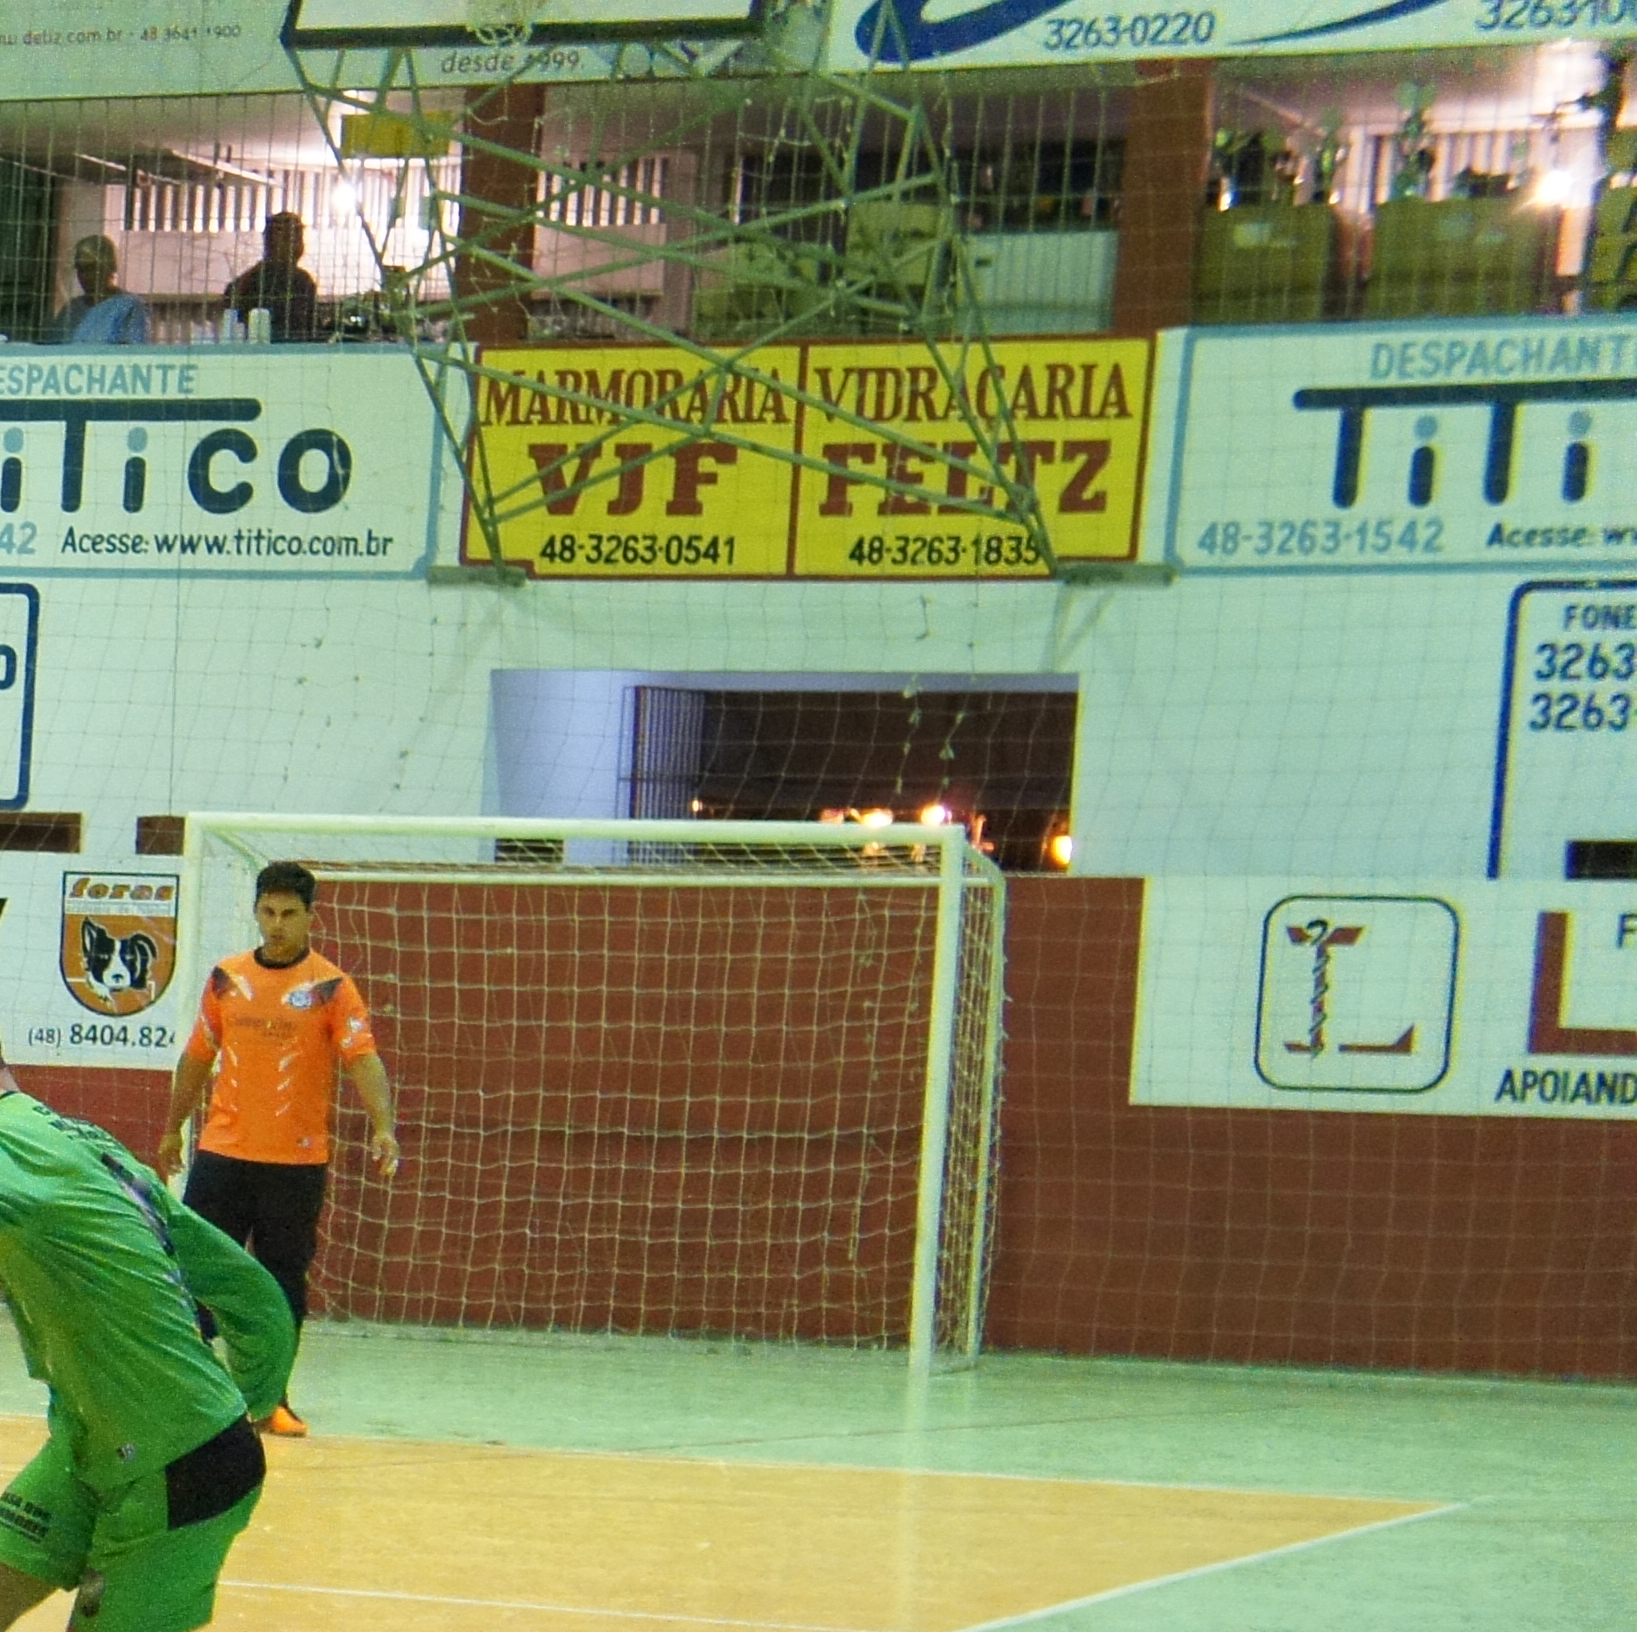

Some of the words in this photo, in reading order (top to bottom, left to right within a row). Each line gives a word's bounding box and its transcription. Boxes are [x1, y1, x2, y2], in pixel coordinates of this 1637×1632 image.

[440, 49, 514, 74] desde
[480, 367, 792, 427] MARMORARIA
[815, 362, 1134, 430] VIDRAÇARIA
[528, 442, 737, 516] VJF
[819, 438, 1112, 517] FELTZ
[154, 528, 394, 557] www.titico.com.br
[28, 1028, 62, 1047] (48)
